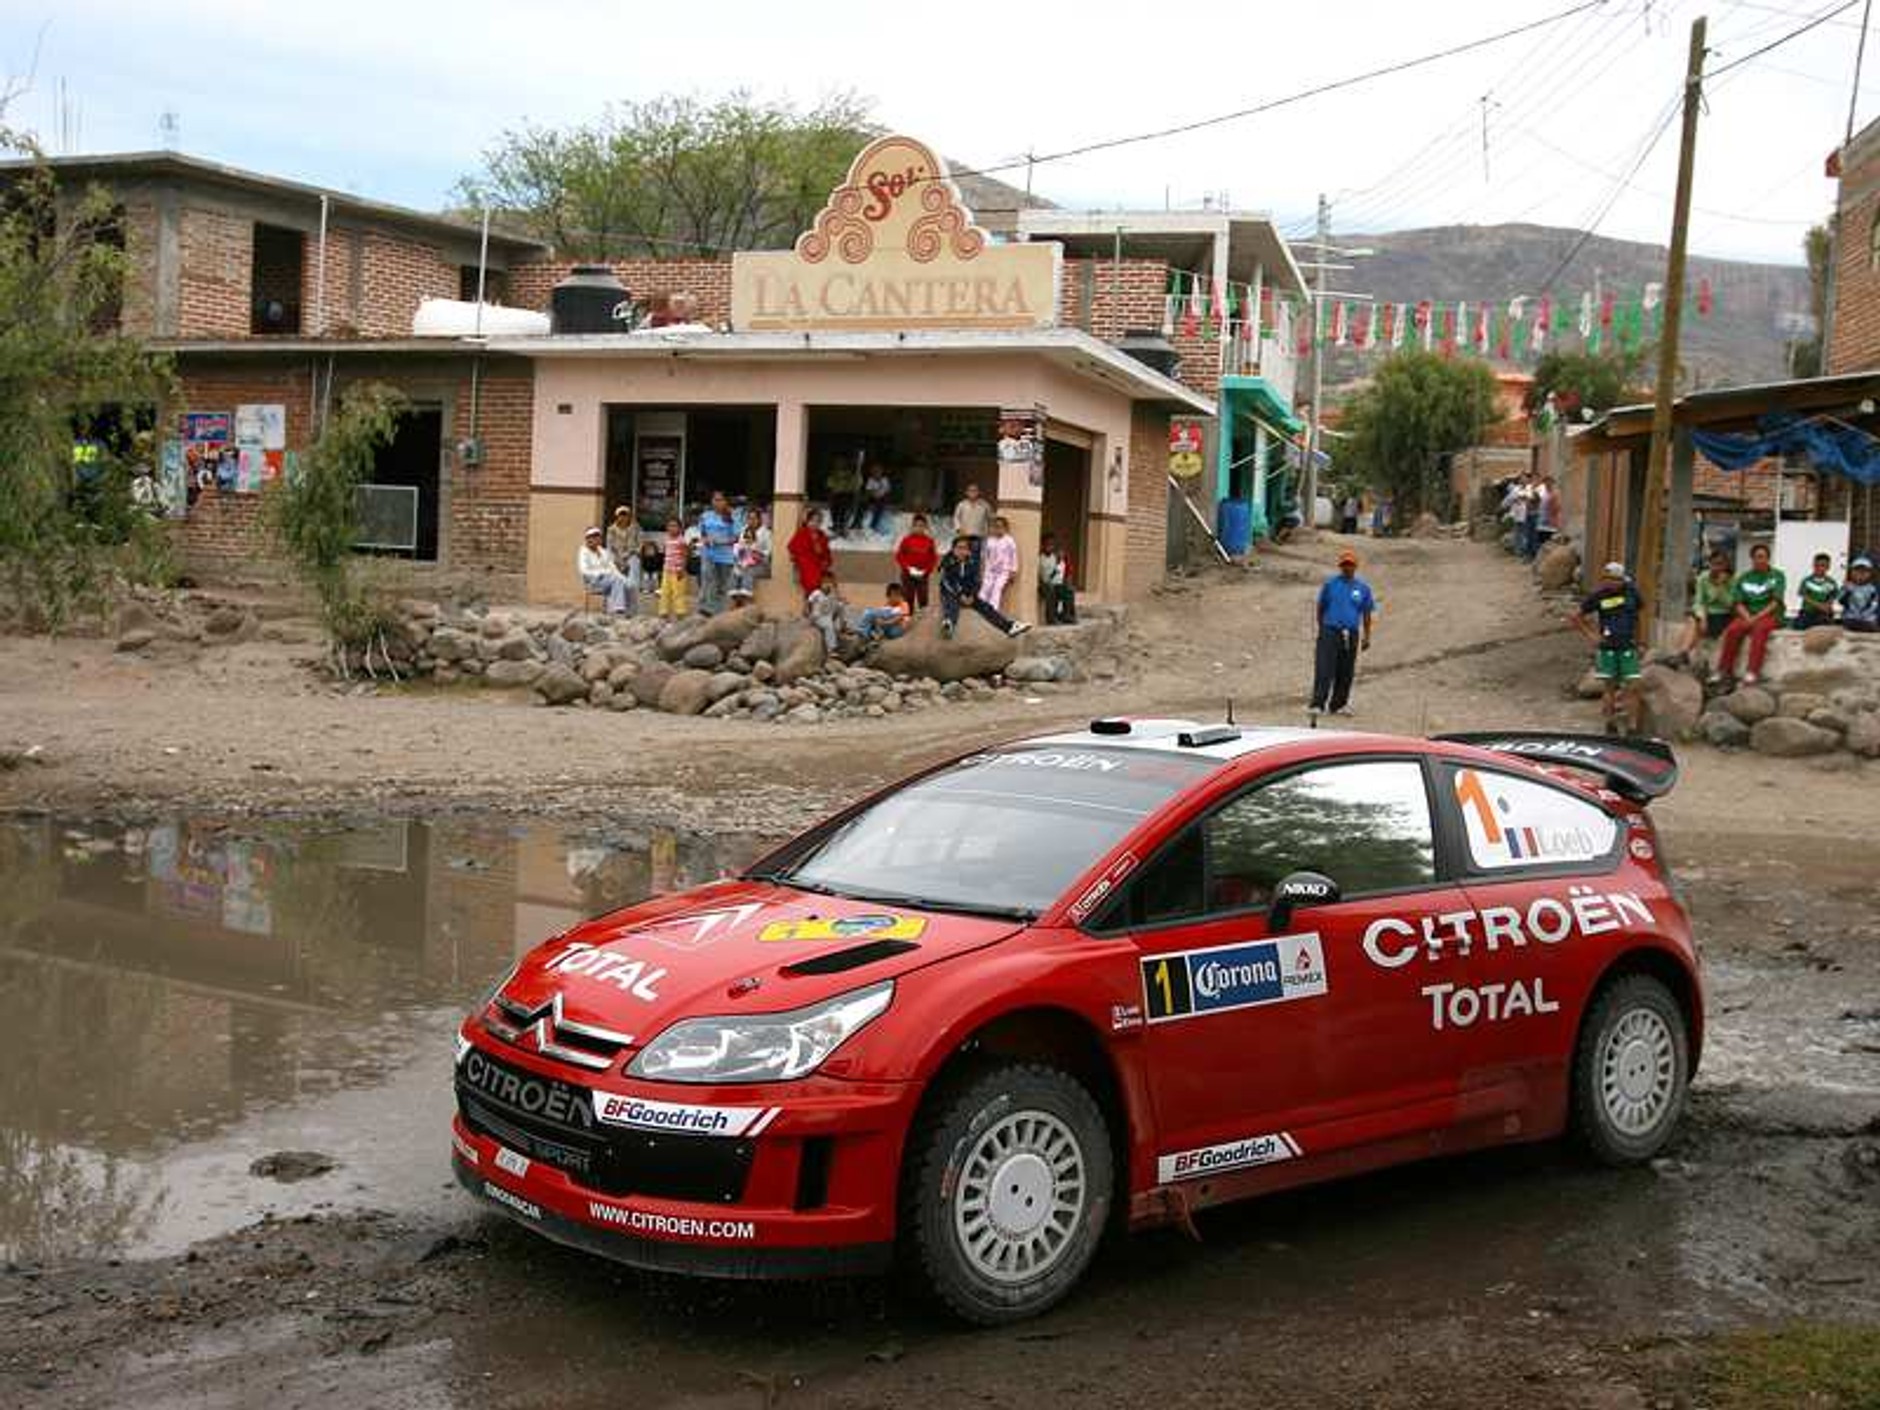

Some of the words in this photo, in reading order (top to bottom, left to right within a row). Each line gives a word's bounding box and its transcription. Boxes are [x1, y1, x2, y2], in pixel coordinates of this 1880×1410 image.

[863, 166, 917, 221] Sol
[752, 274, 809, 316] LA
[819, 273, 1035, 316] CANTERA
[1455, 770, 1502, 844] 1
[1282, 882, 1328, 897] NIKKO
[1363, 886, 1656, 968] CITROËN
[545, 942, 667, 1001] TOTAL
[1155, 960, 1173, 1015] 1
[1195, 960, 1278, 1000] Corona
[1422, 978, 1560, 1030] TOTAL
[466, 1052, 594, 1128] CITROËN
[603, 1098, 728, 1130] BFGoodrich
[1175, 1139, 1276, 1172] BFGoodrich
[589, 1203, 755, 1239] WWW.CITROEN.COM
